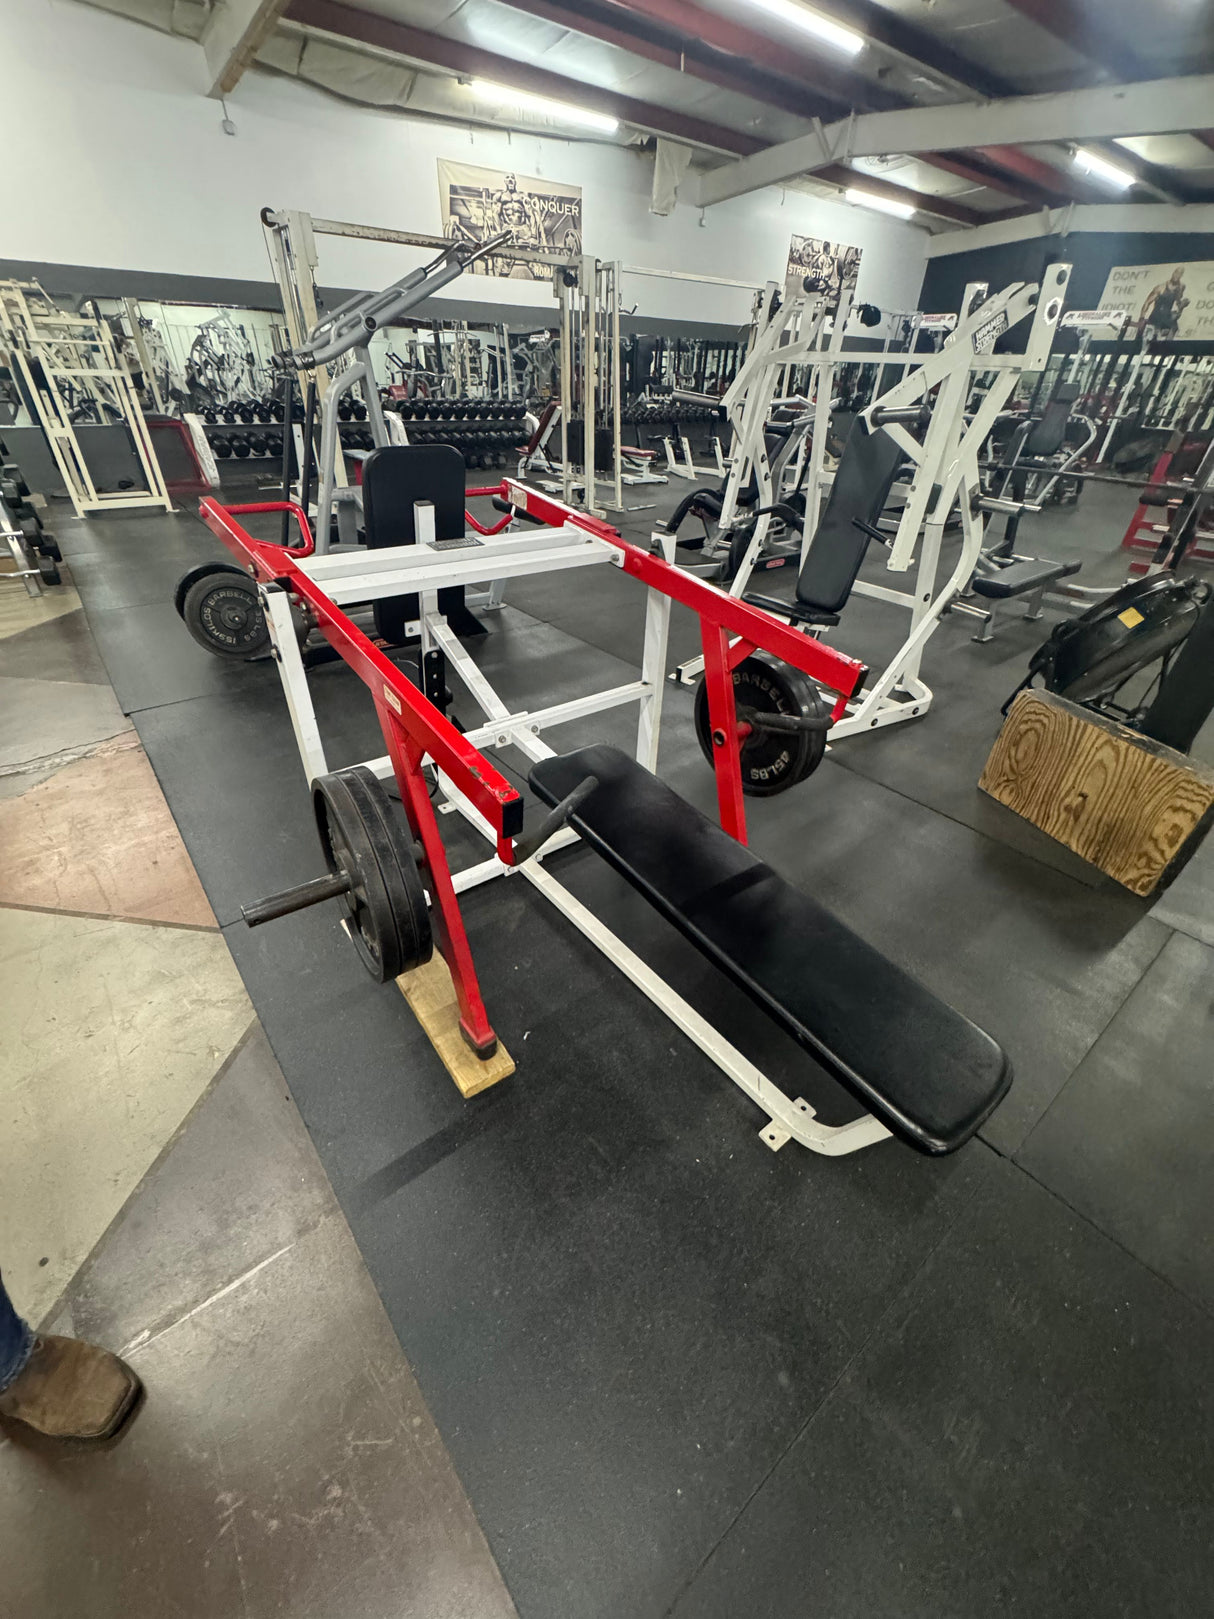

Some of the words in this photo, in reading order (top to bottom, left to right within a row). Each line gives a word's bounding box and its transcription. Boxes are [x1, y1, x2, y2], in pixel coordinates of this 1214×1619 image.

[523, 197, 579, 217] CONQUER
[788, 264, 825, 279] STRENGTH
[1113, 270, 1150, 281] DON'T
[1112, 285, 1136, 295] THE
[208, 591, 252, 606] BARBELL
[733, 672, 788, 715] BARBEL
